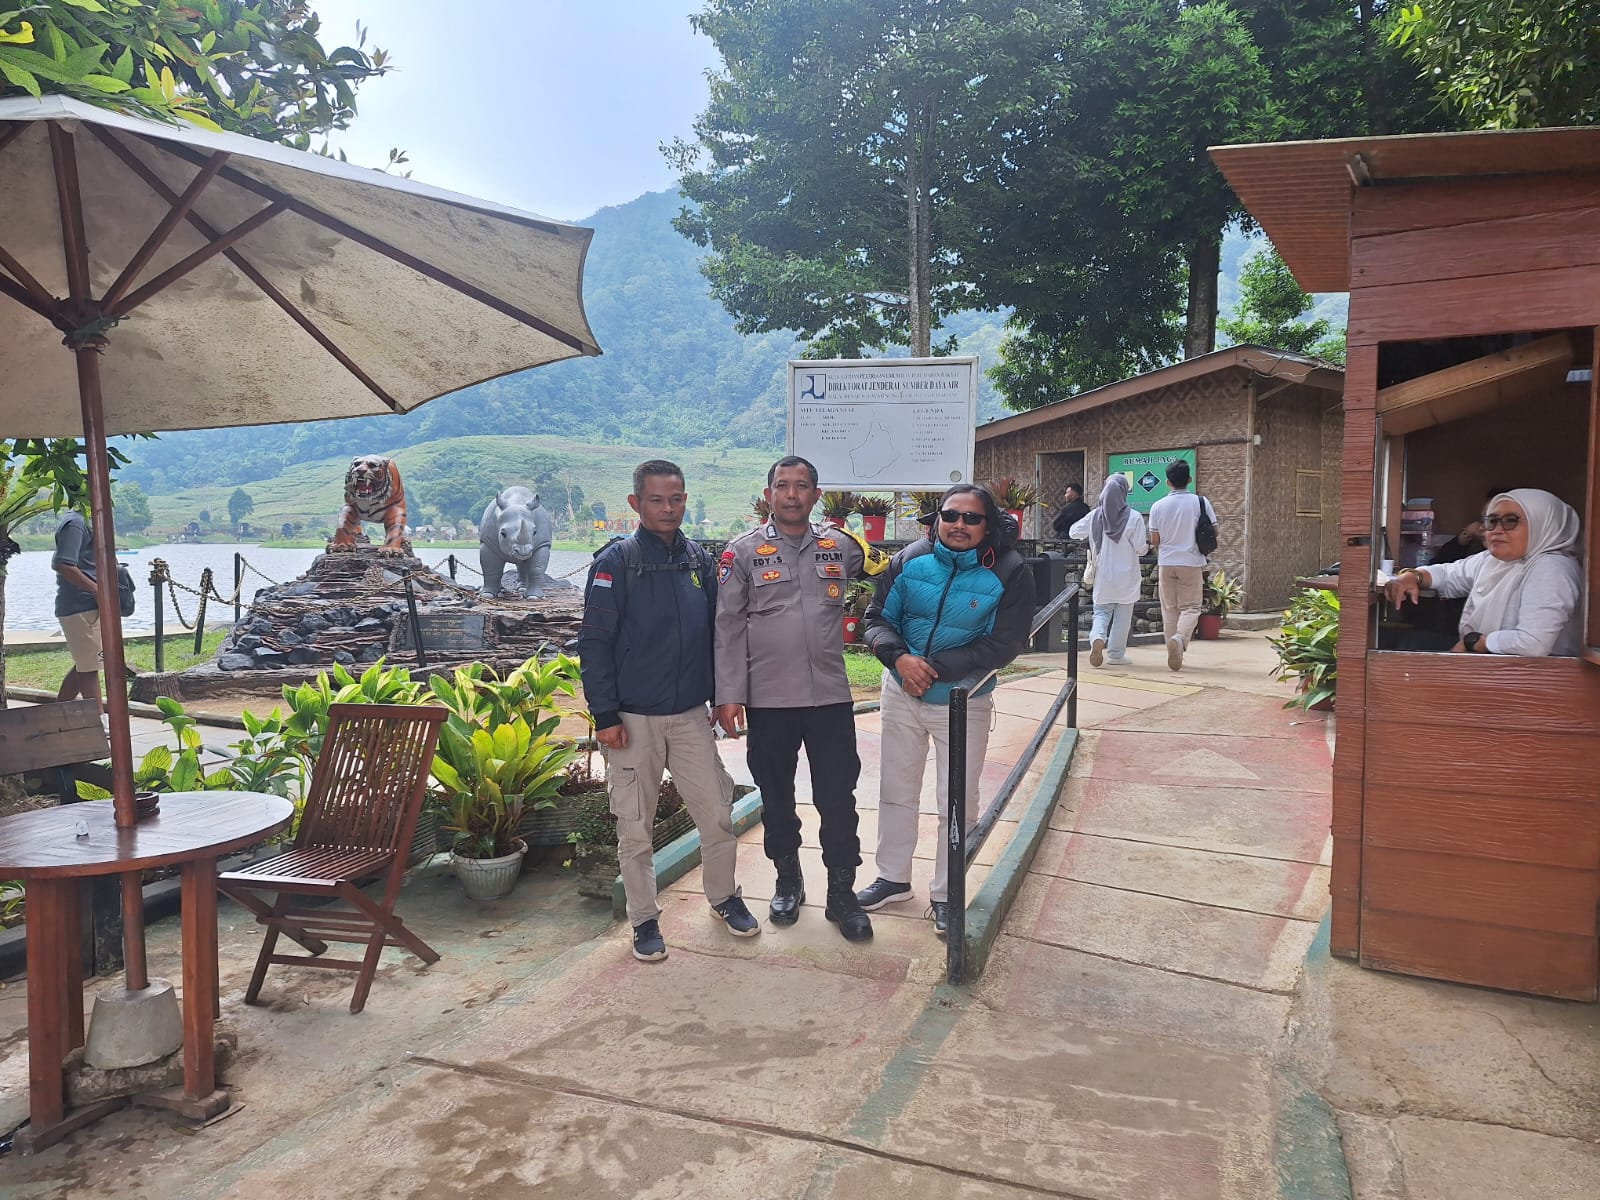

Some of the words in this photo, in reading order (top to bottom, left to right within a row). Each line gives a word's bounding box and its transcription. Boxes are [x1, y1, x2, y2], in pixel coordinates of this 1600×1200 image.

[828, 382, 867, 391] DIREKTORAT
[868, 382, 900, 391] JENDERAL
[902, 381, 928, 390] SUMBER
[929, 380, 947, 390] DAYA
[948, 380, 959, 389] AIR
[1123, 456, 1153, 465] RUMAH
[815, 552, 843, 561] POLRI
[752, 557, 770, 567] EDY
